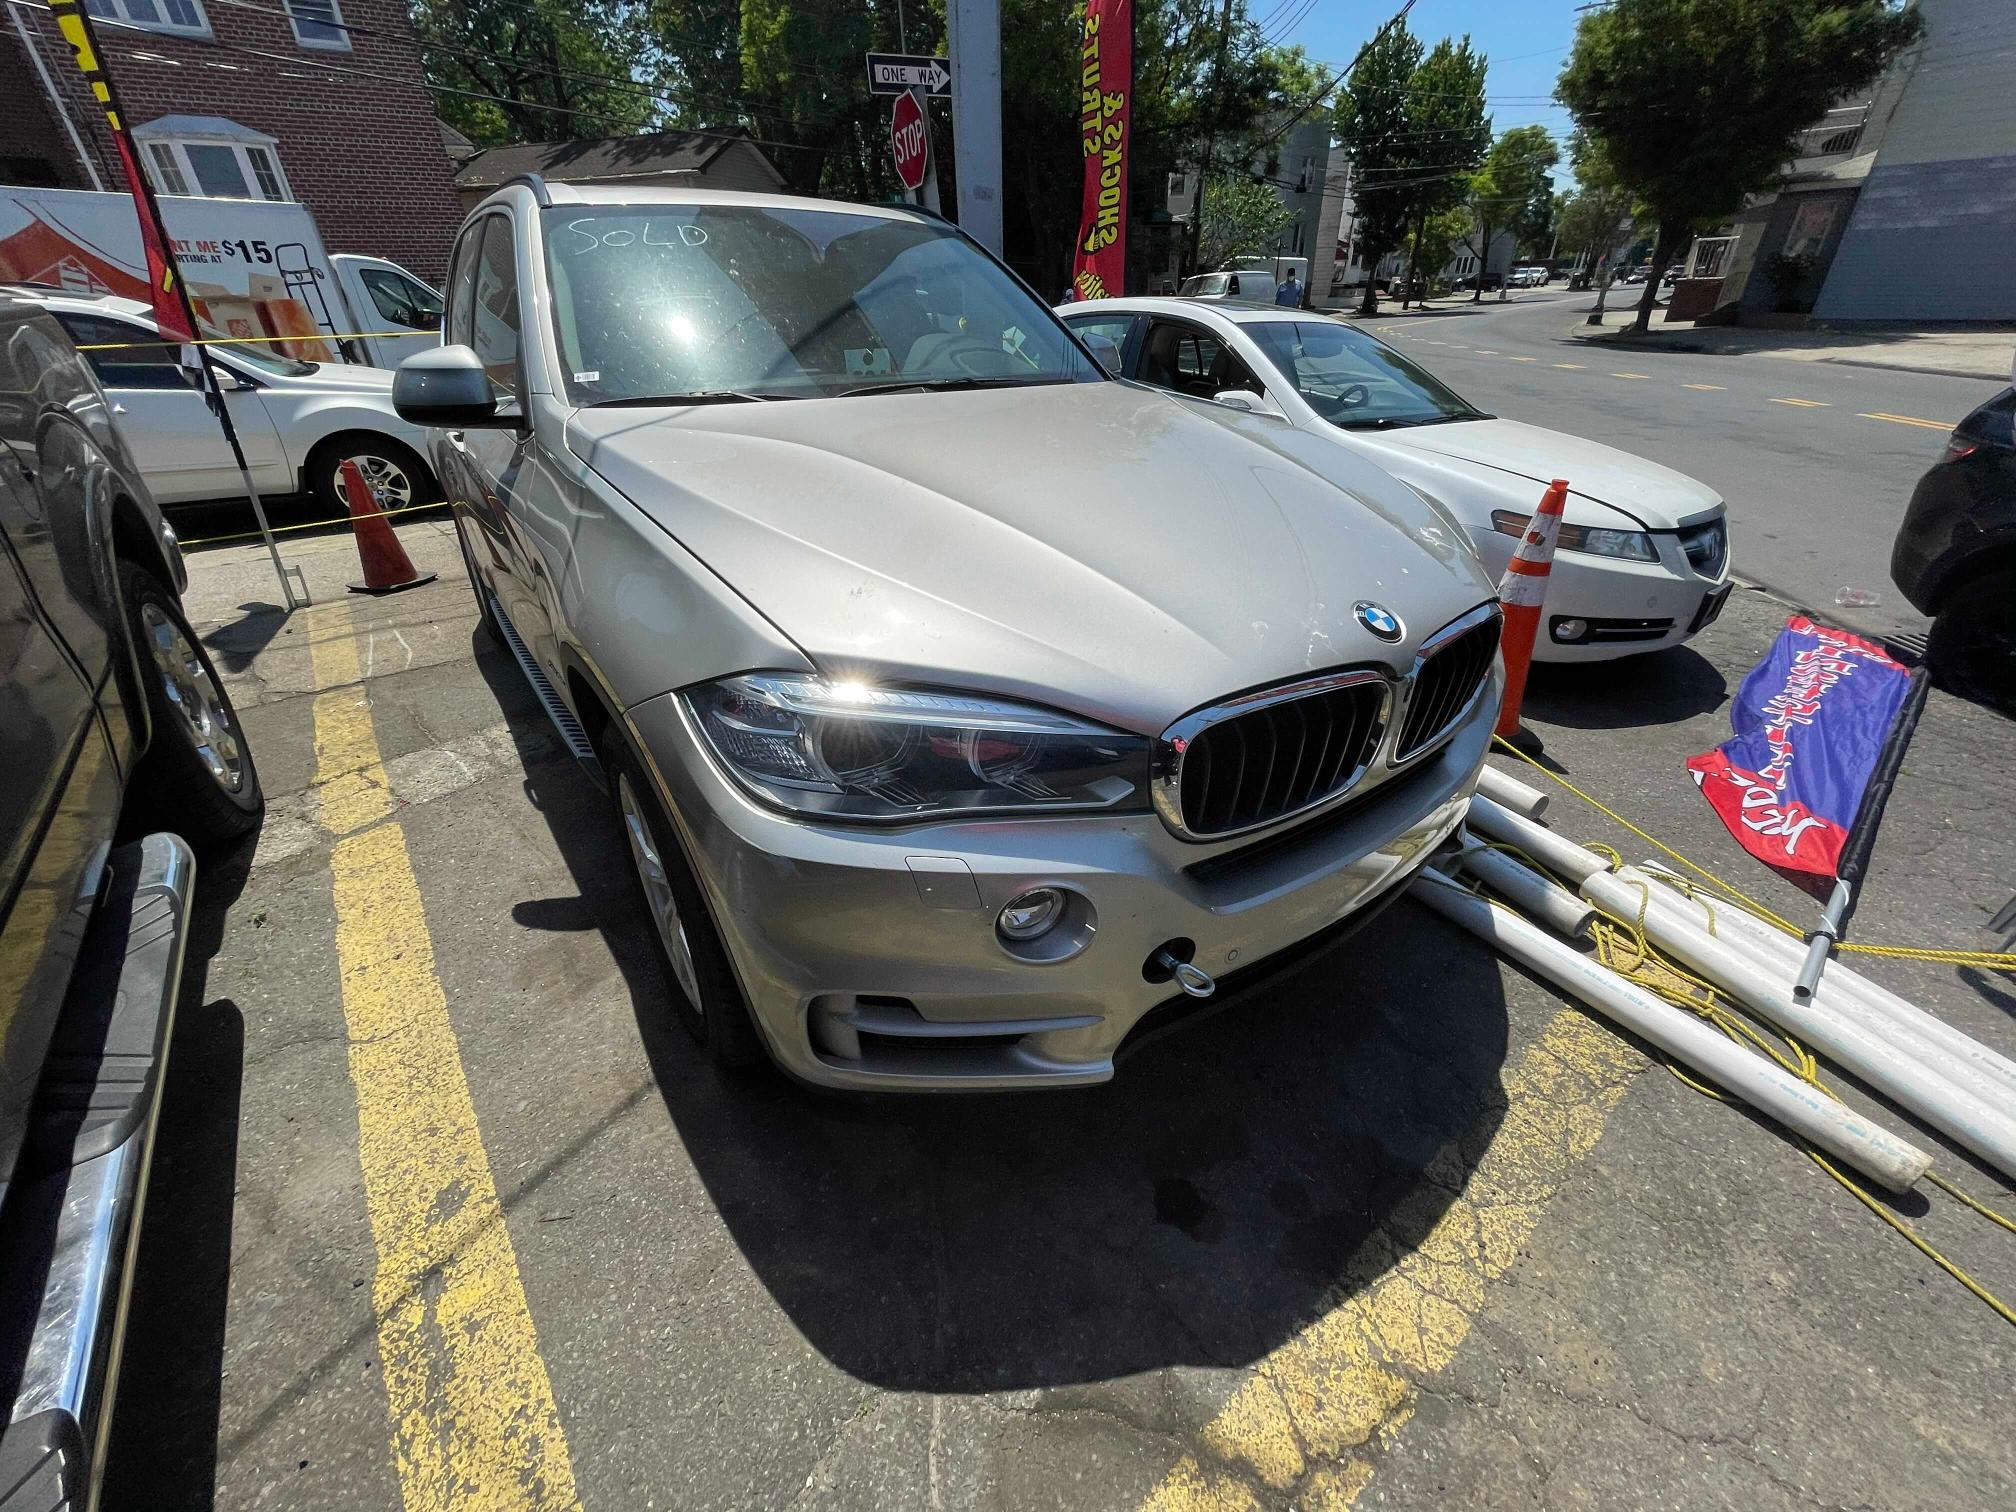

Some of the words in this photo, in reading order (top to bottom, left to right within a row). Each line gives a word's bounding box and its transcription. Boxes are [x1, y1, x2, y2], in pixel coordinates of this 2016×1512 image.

[881, 66, 908, 82] ONE
[918, 68, 942, 84] WAY
[895, 118, 923, 164] STOP
[174, 239, 192, 253] NT
[195, 240, 222, 254] ME
[568, 217, 709, 256] SOLD
[176, 253, 208, 264] RTING
[210, 254, 223, 264] AT
[221, 239, 274, 264] $15
